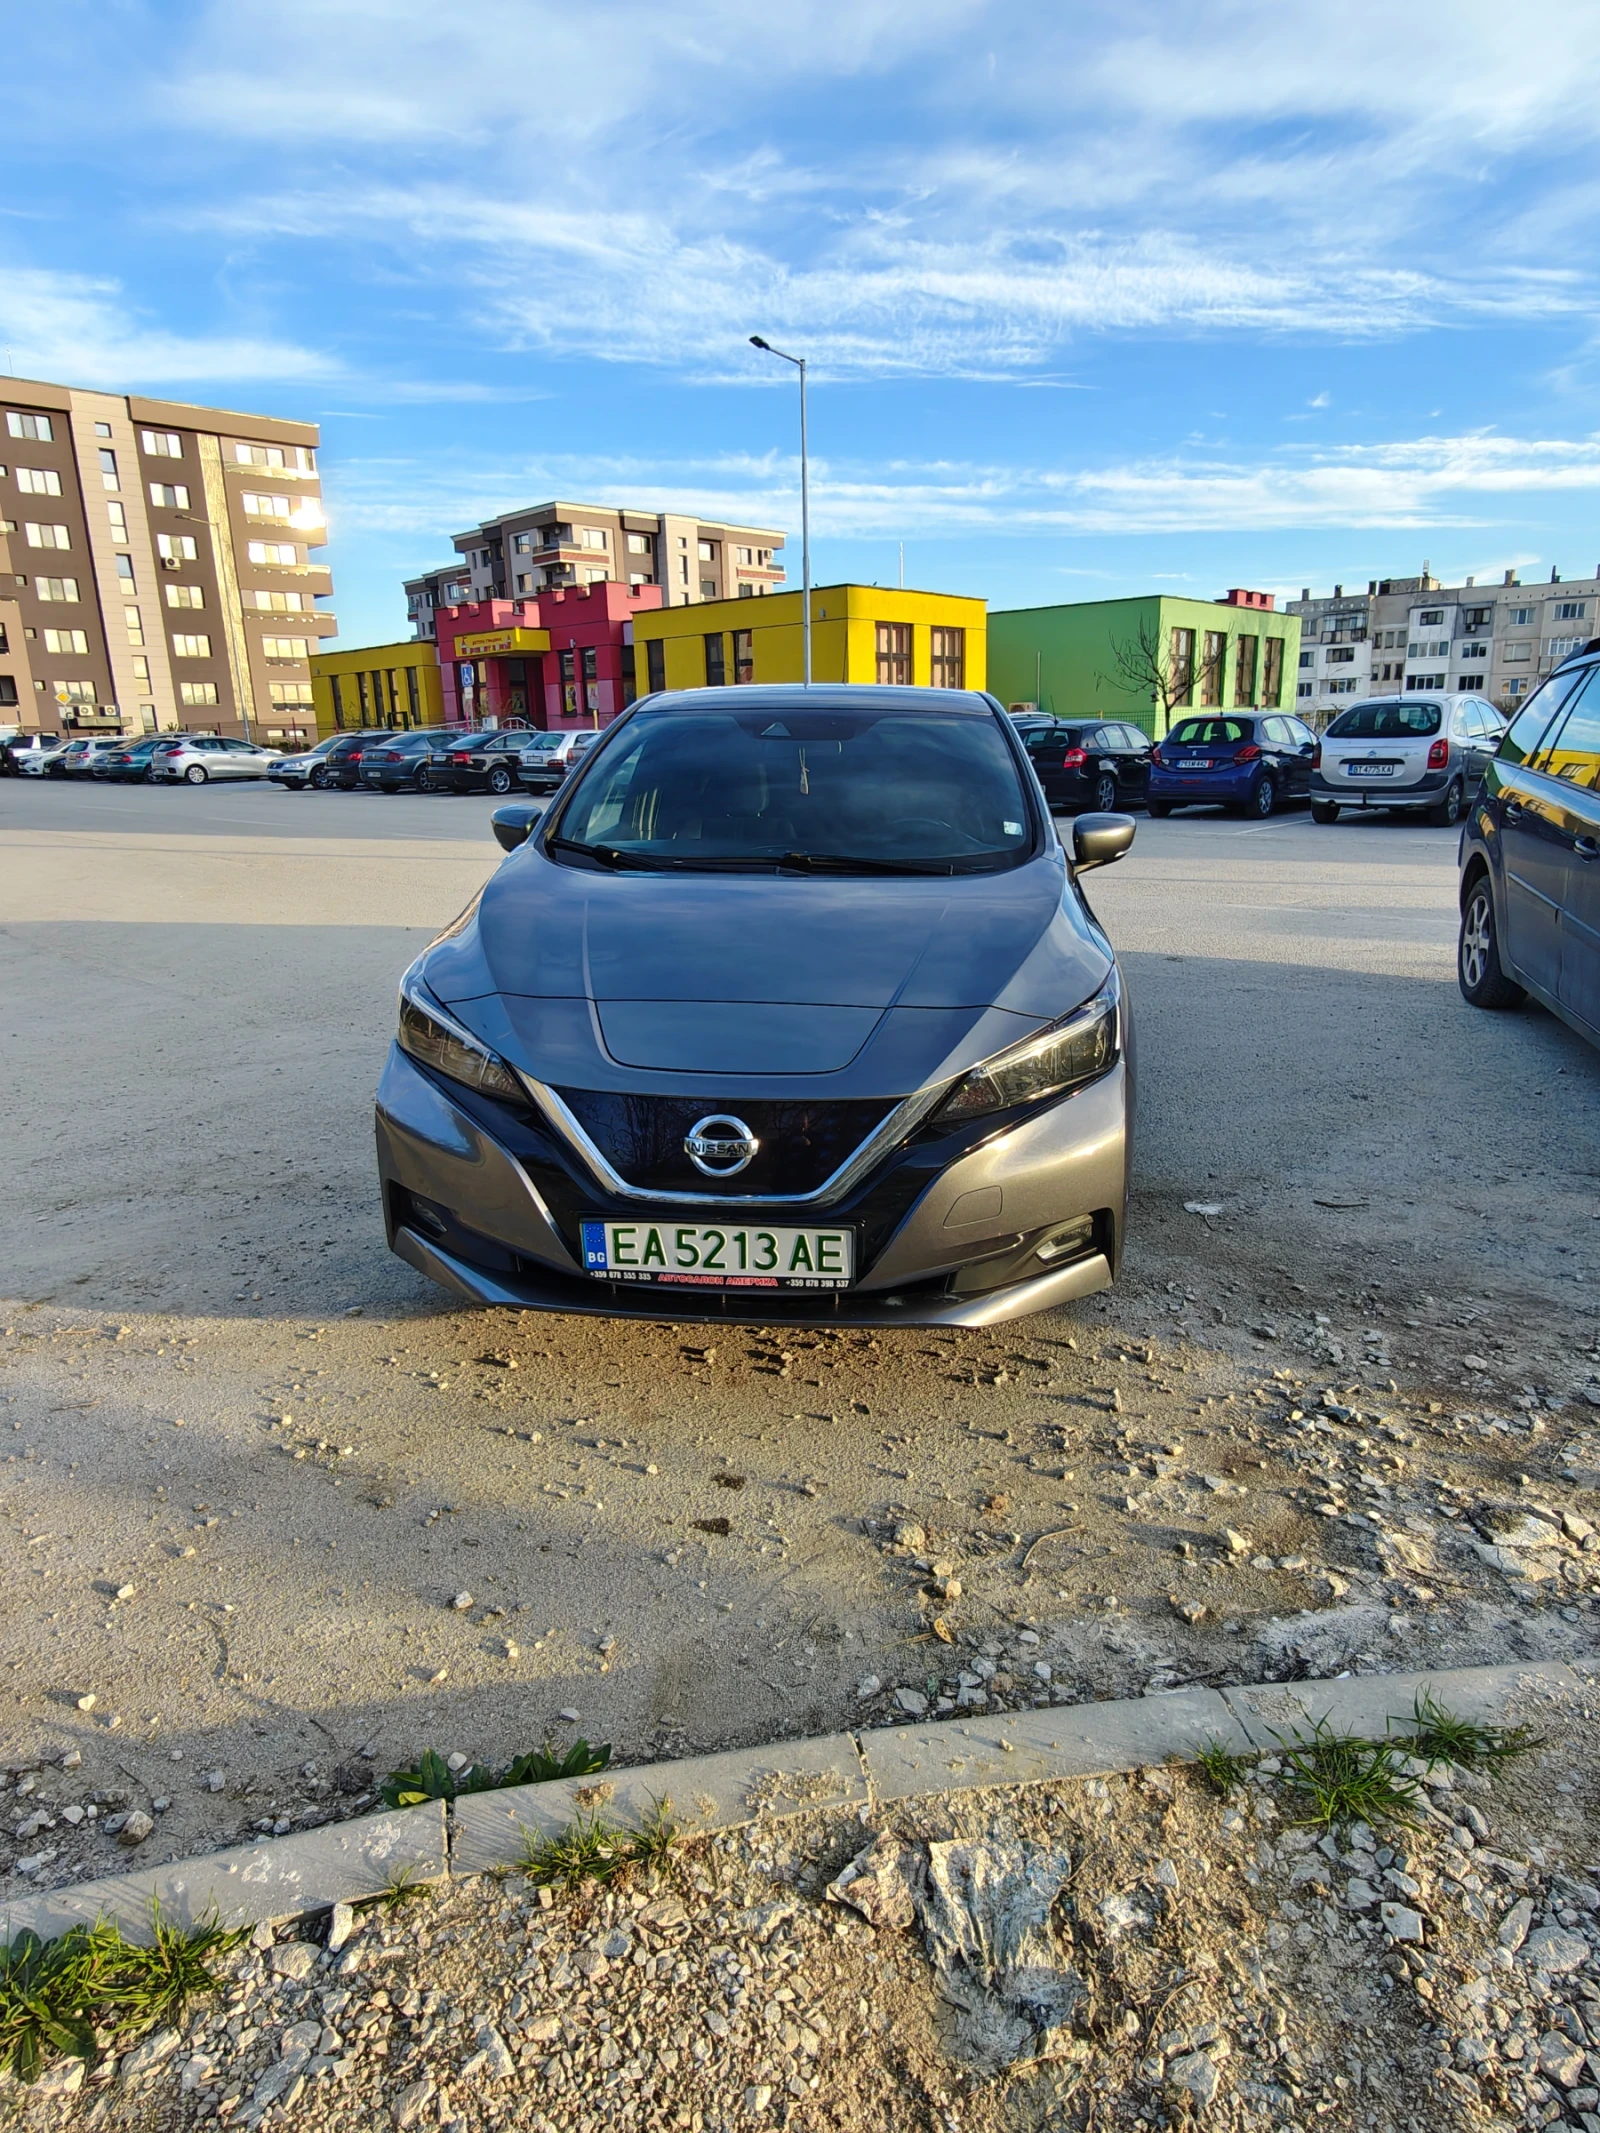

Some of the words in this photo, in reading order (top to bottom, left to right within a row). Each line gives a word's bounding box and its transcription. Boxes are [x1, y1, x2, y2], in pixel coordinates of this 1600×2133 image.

[690, 1142, 750, 1154] NISSAN
[588, 1252, 606, 1263] BG
[657, 1273, 724, 1285] АВТОСАЛОН
[725, 1277, 779, 1287] АМЕРИКА
[785, 1279, 804, 1287] +359
